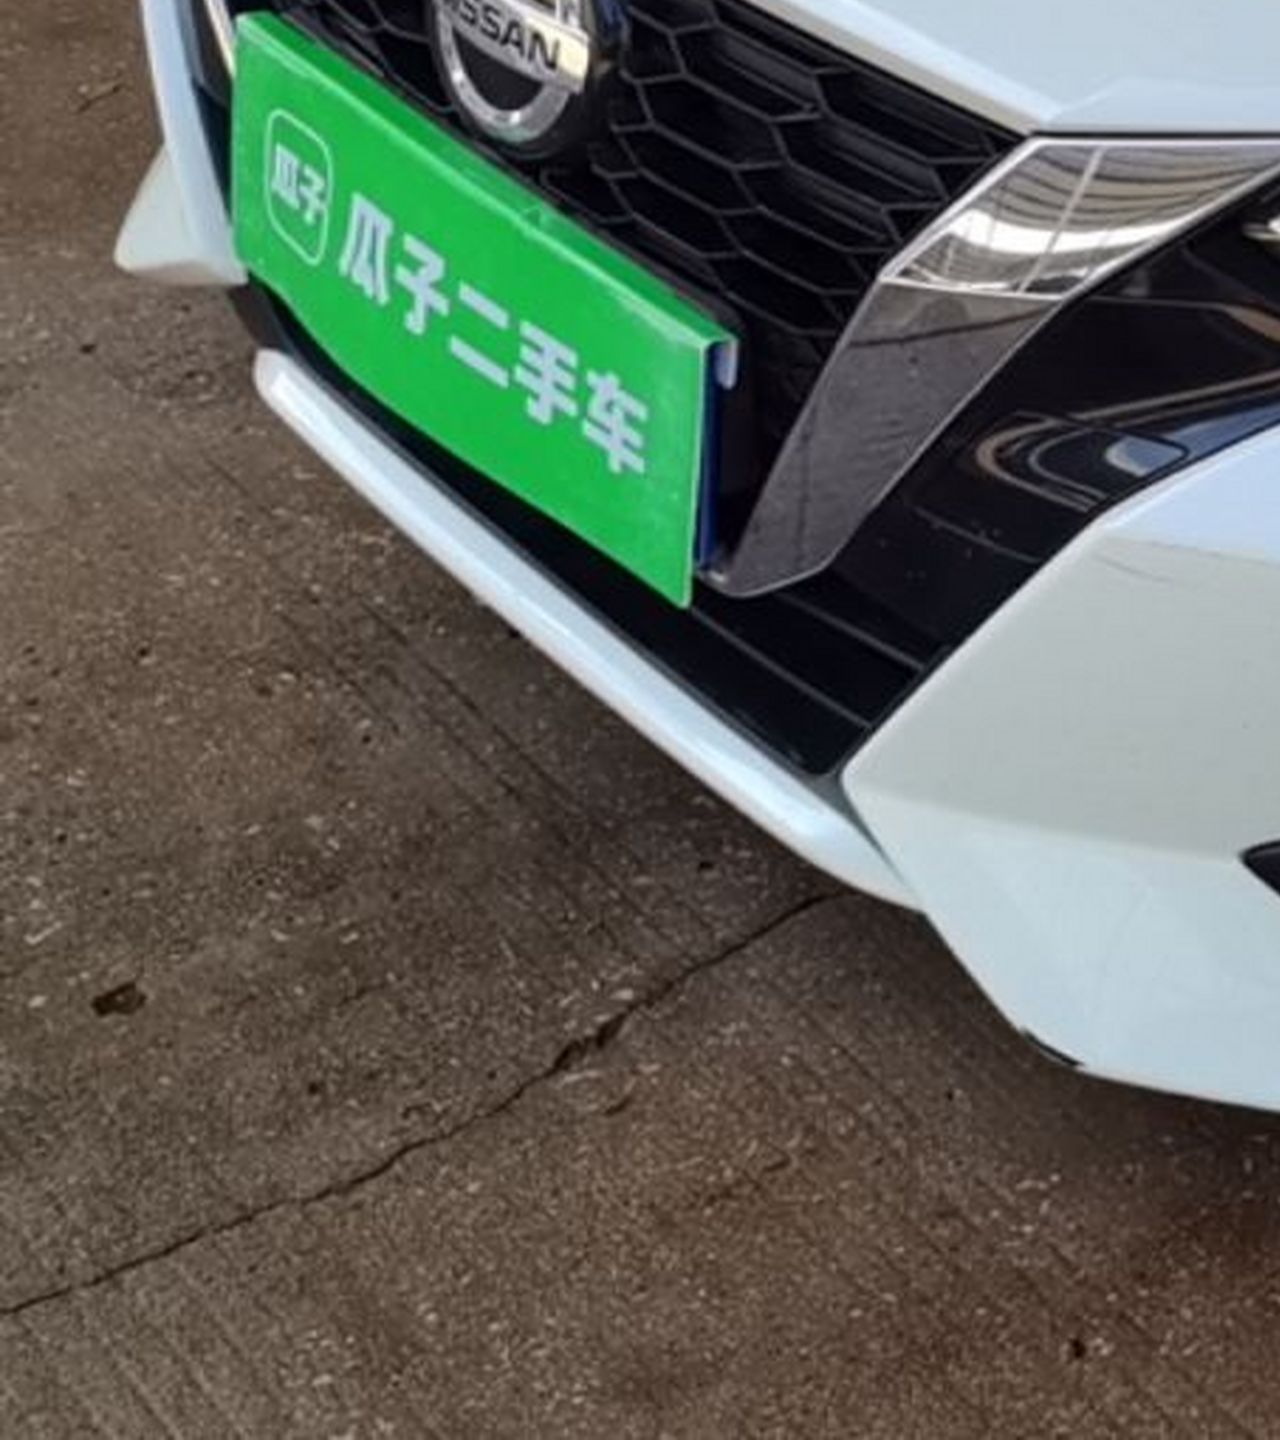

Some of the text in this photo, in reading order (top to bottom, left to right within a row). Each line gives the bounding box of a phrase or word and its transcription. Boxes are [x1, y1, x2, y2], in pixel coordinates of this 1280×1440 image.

[271, 142, 327, 225] 瓜子
[338, 192, 649, 474] 瓜子二手车
